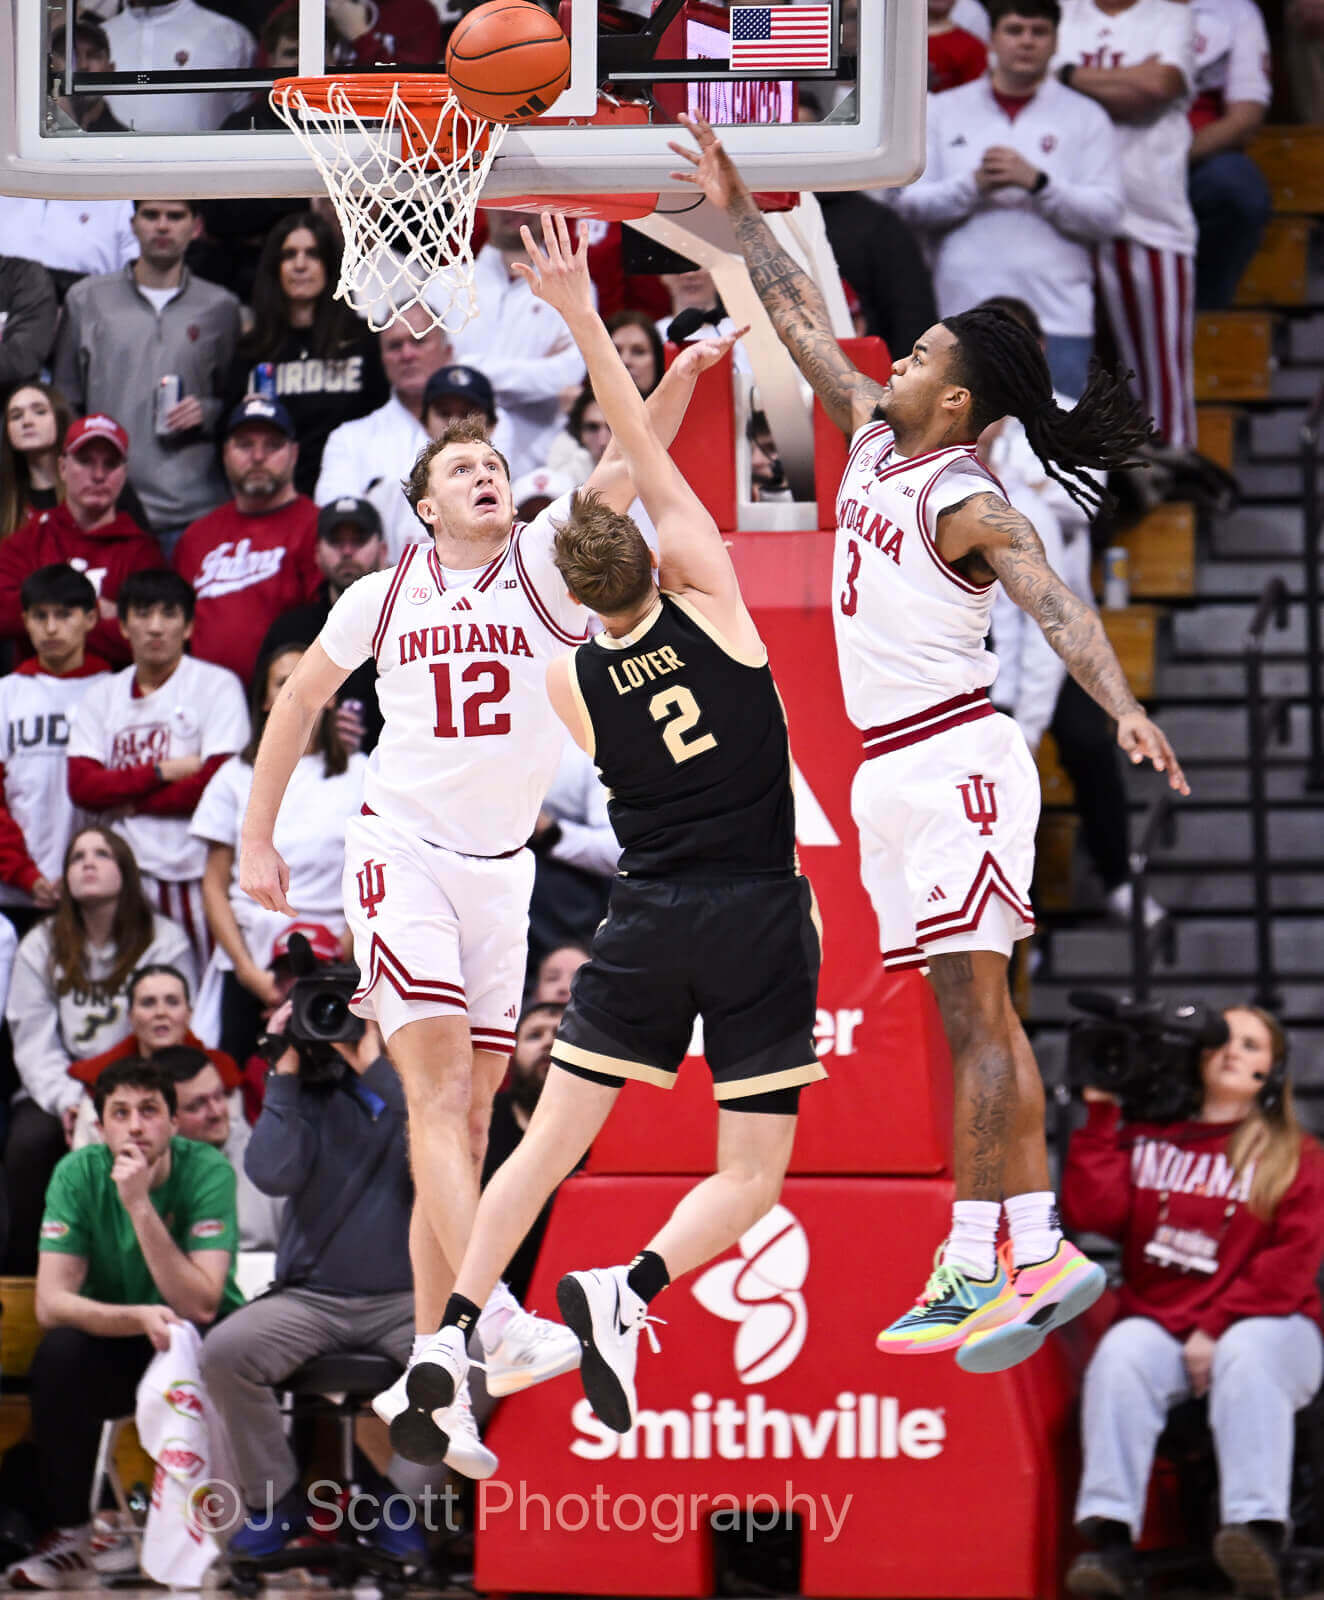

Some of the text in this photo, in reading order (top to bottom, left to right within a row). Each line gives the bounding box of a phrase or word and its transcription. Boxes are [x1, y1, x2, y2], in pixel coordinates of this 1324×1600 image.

[838, 498, 905, 566] NDIANA
[411, 587, 429, 600] 76
[840, 538, 862, 617] 3
[399, 623, 535, 666] INDIANA
[607, 645, 687, 695] LOYER
[429, 660, 512, 738] 12
[648, 684, 719, 765] 2
[1129, 1136, 1256, 1203] INDIANA
[569, 1392, 946, 1460] Smithville
